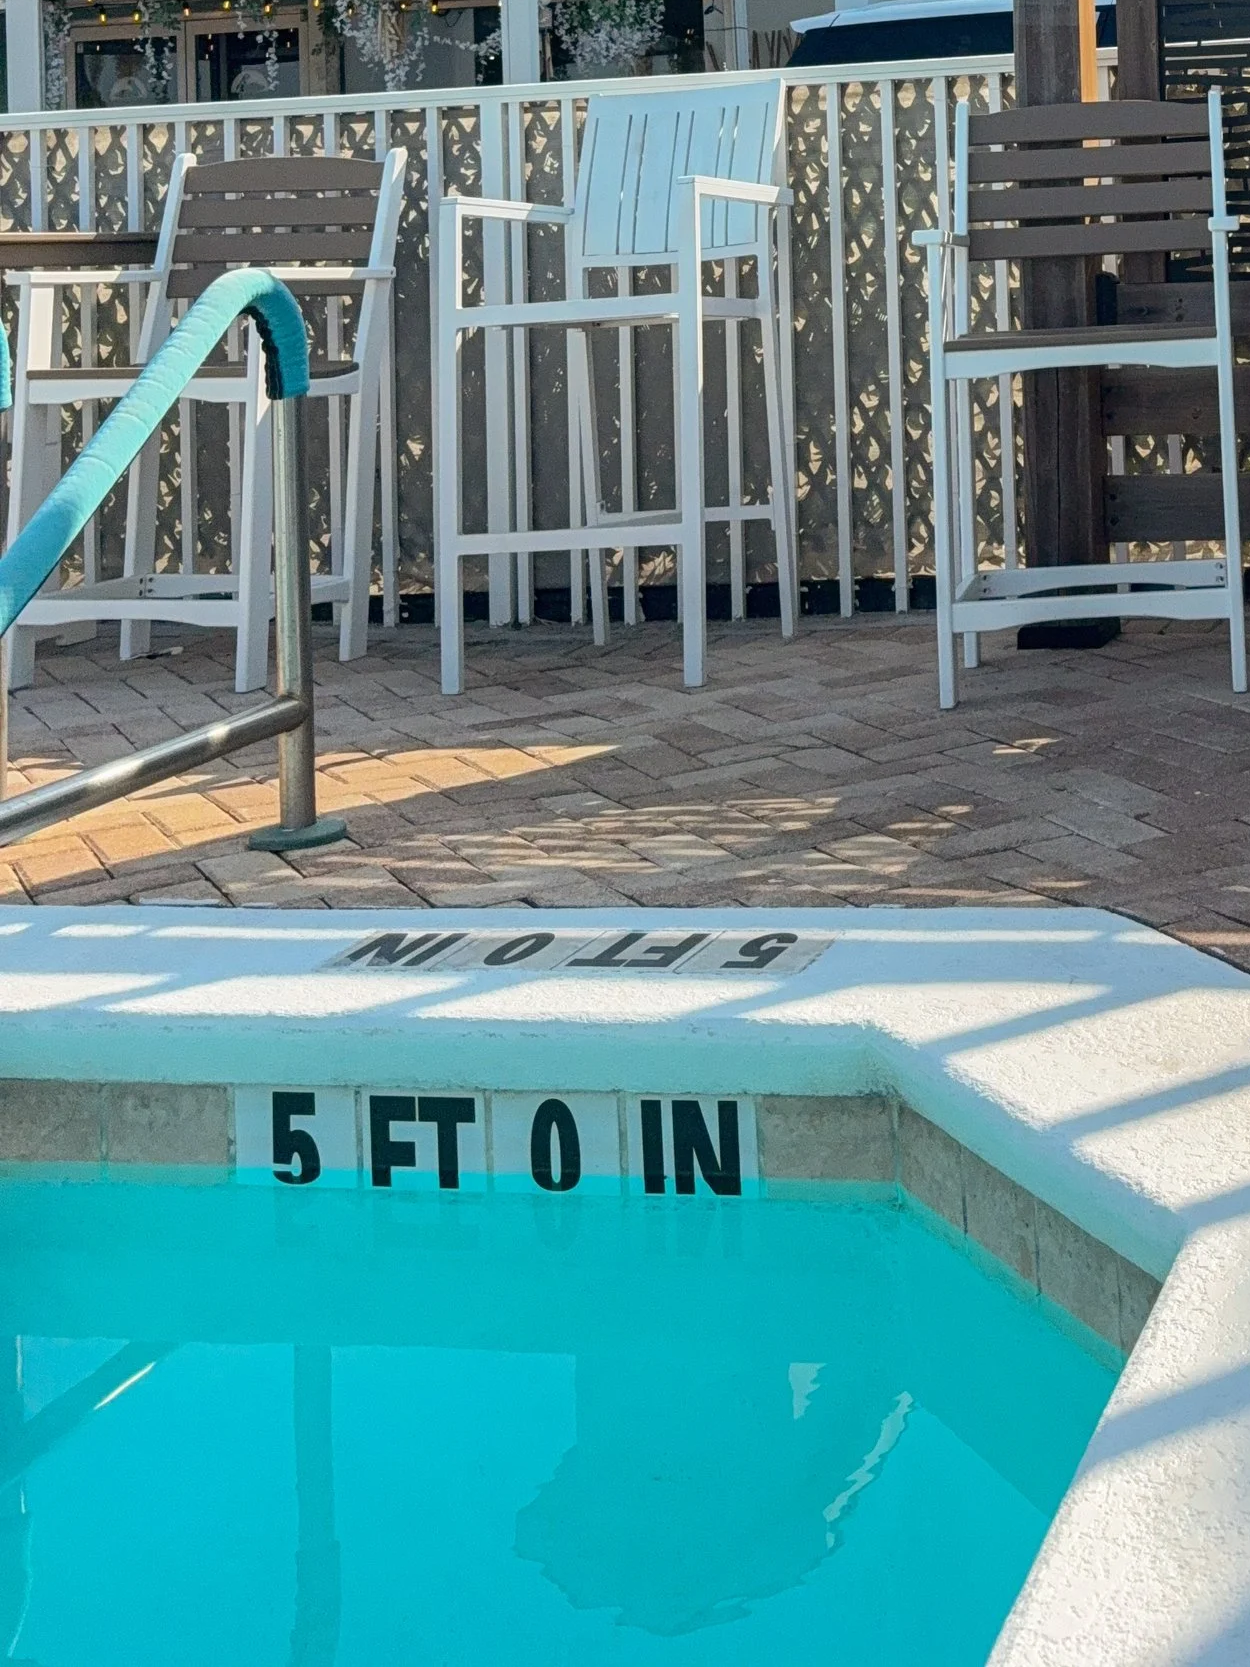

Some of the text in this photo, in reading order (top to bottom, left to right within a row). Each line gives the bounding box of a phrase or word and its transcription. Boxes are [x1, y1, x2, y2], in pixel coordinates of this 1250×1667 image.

[342, 932, 468, 967] IN
[567, 932, 710, 968] FT
[720, 932, 798, 969] 5
[272, 1091, 321, 1185] 5
[369, 1095, 476, 1189] FT
[640, 1099, 742, 1196] IN
